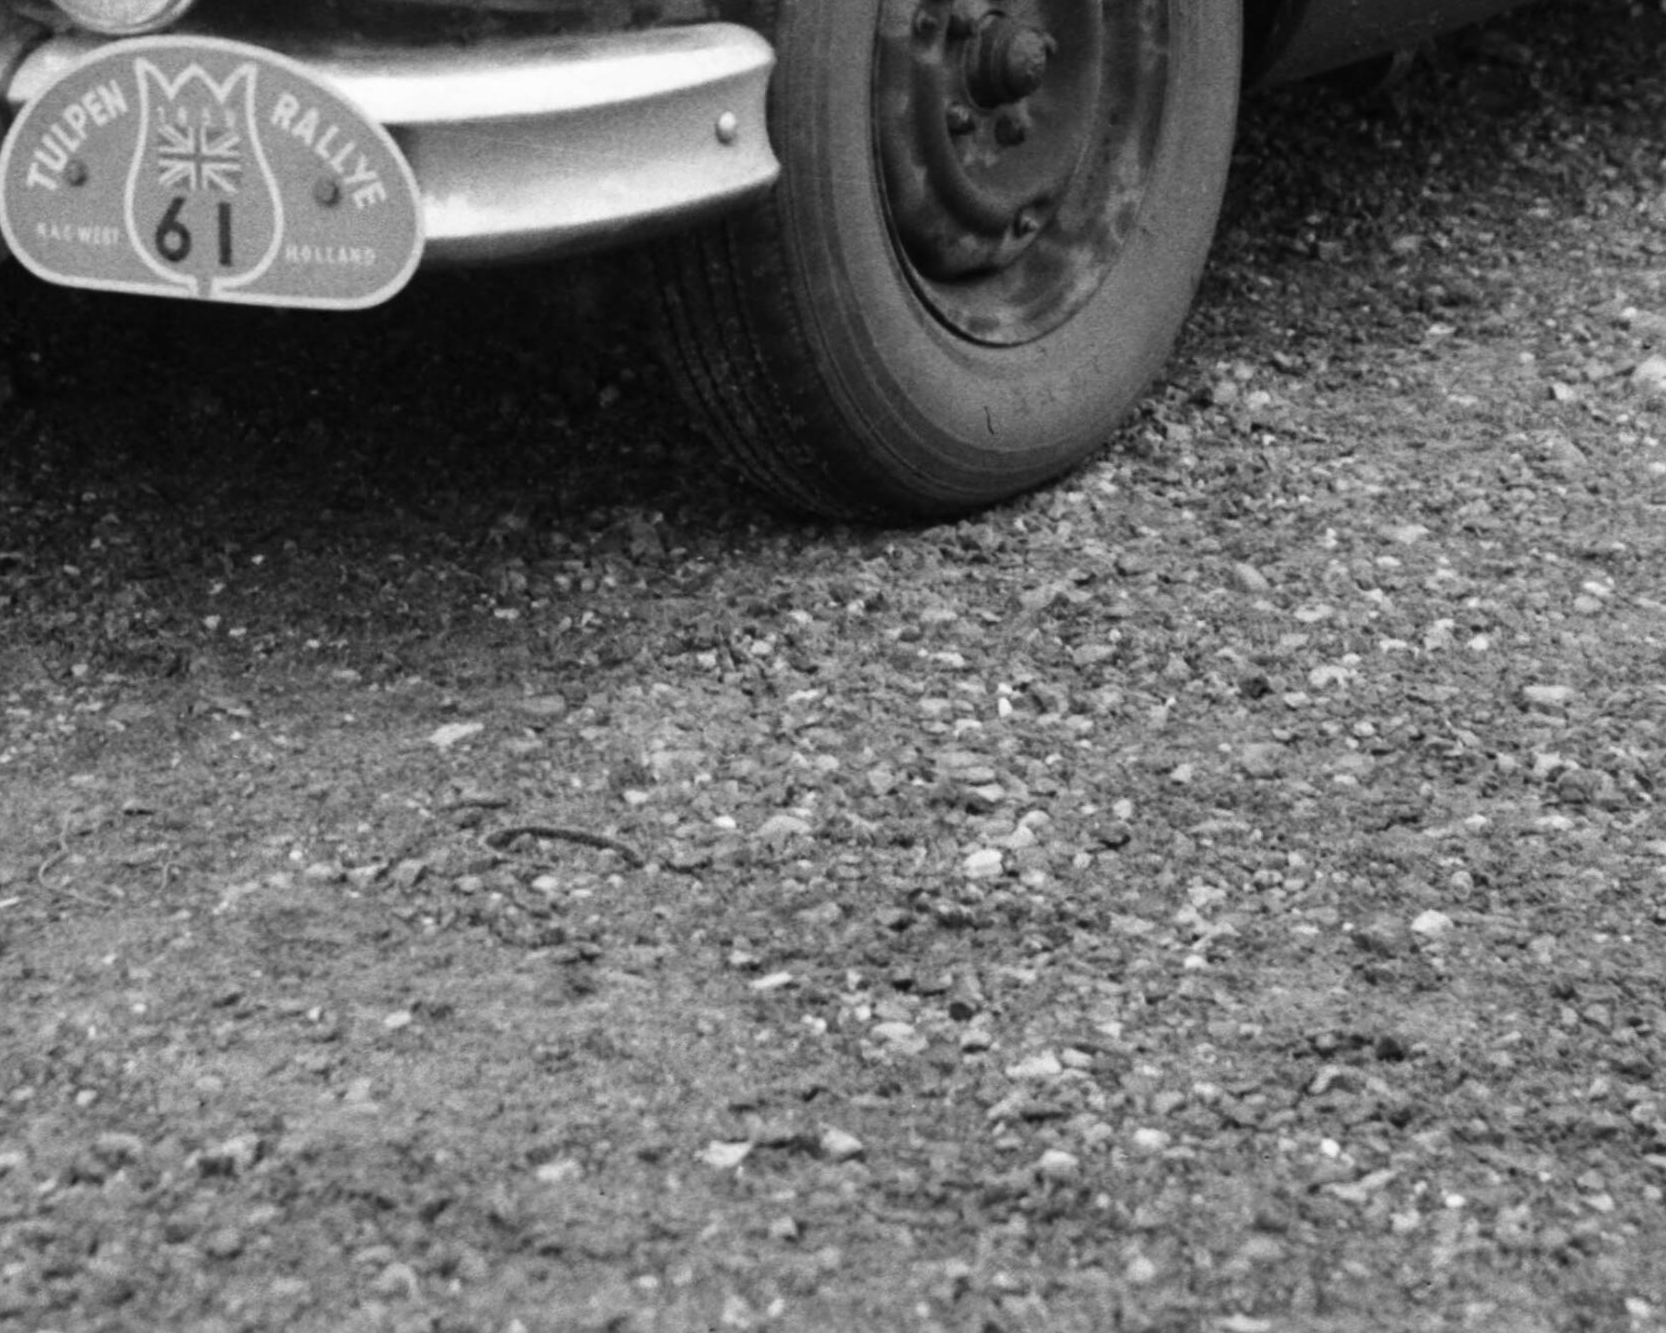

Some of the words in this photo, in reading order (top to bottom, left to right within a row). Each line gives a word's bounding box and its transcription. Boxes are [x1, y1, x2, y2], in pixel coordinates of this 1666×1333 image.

[26, 78, 130, 192] TULPEN
[269, 93, 388, 211] RALLYE
[153, 196, 233, 266] 61
[285, 244, 376, 266] HOLLAND
